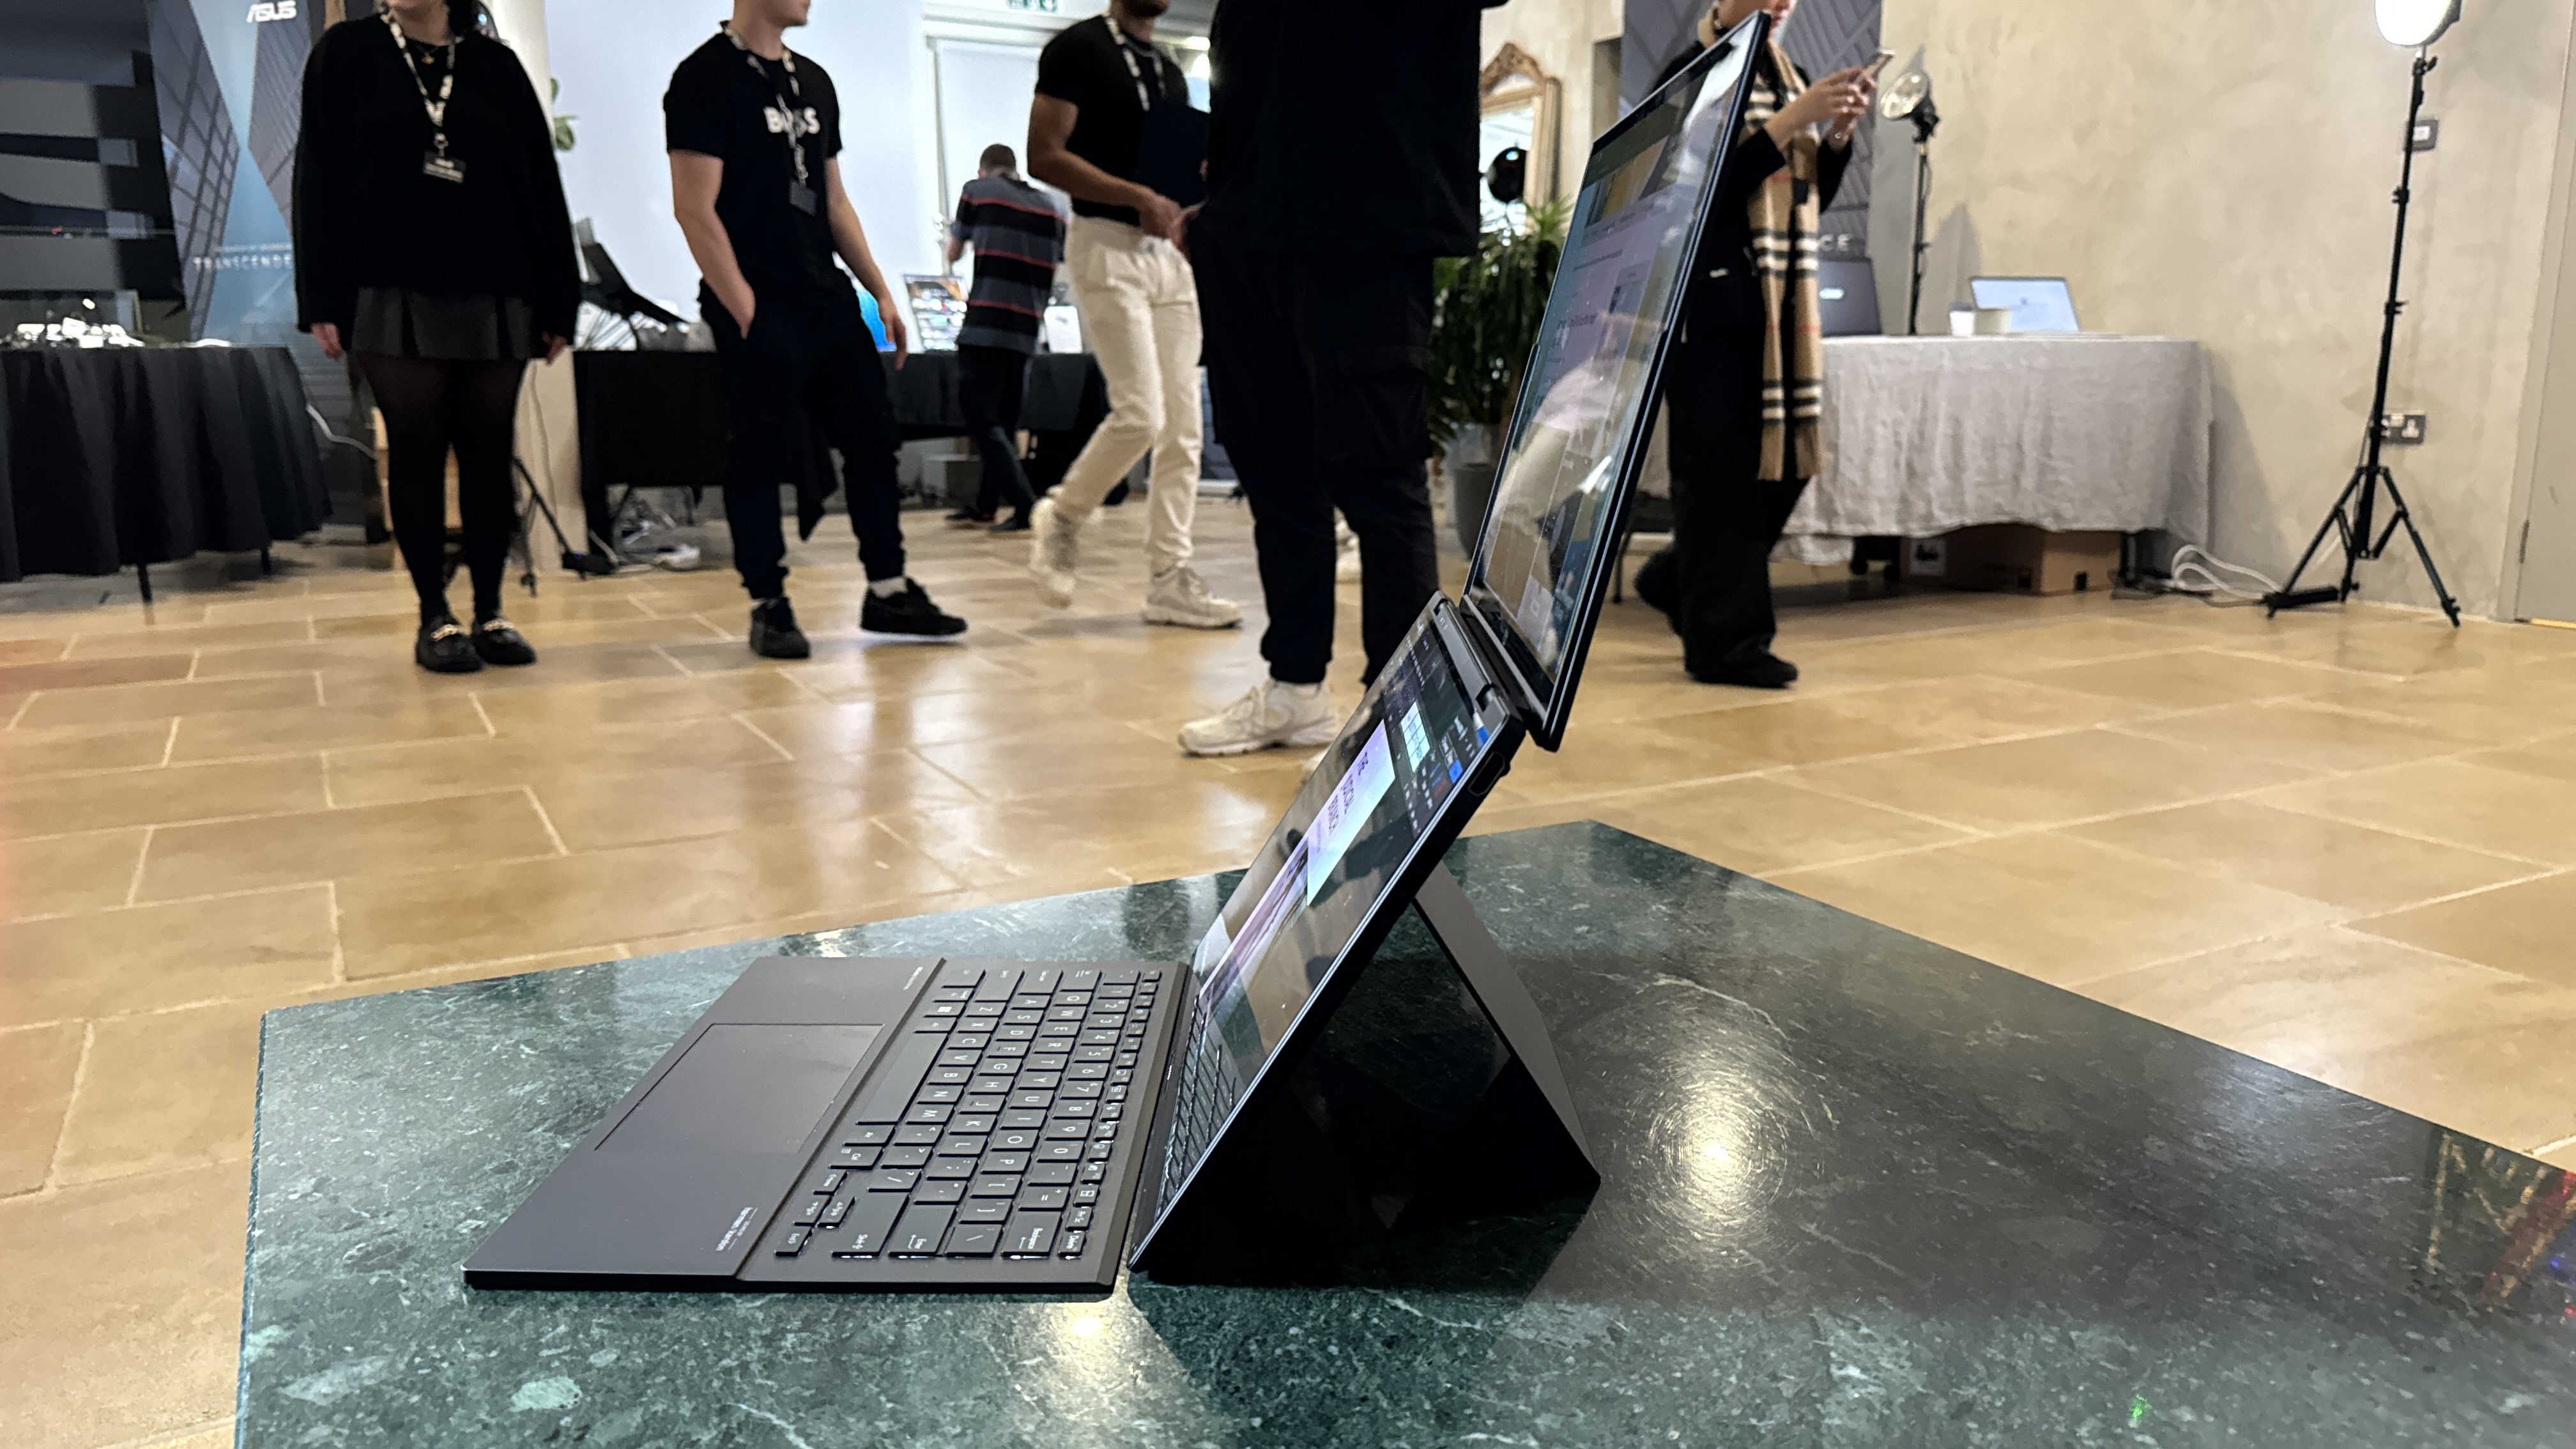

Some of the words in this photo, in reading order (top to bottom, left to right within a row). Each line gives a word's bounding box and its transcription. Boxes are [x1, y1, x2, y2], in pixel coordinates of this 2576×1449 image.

[246, 0, 296, 23] ASUS
[1358, 751, 1368, 776] THE
[1340, 773, 1354, 815] JUDICIAL
[1328, 794, 1339, 836] BRANCH
[914, 1238, 926, 1249] Enter
